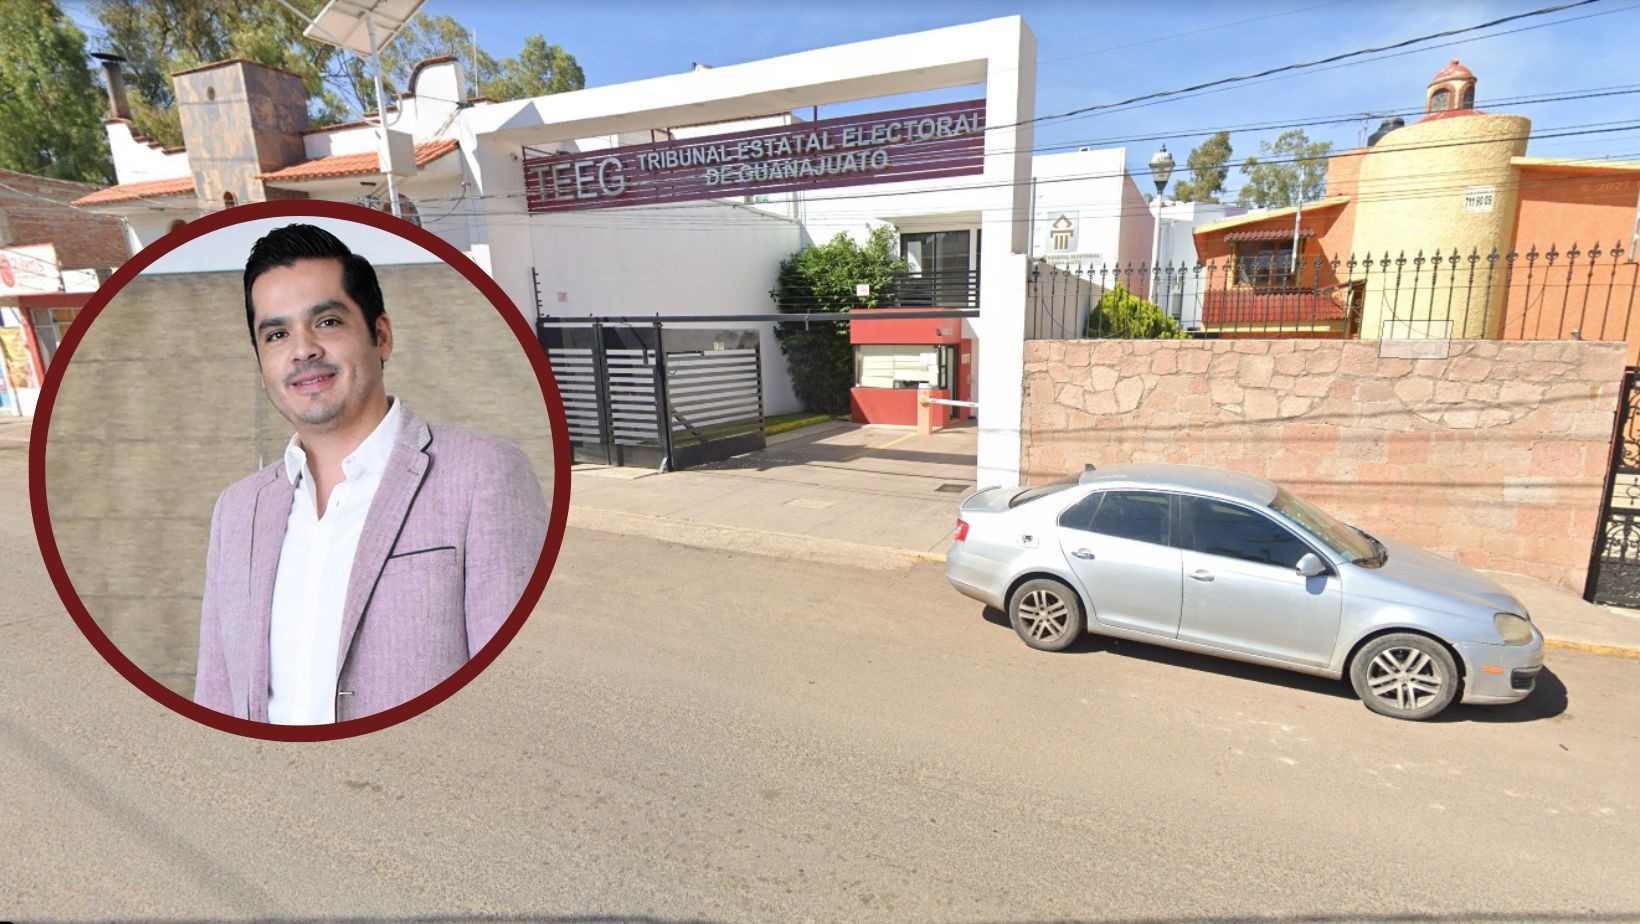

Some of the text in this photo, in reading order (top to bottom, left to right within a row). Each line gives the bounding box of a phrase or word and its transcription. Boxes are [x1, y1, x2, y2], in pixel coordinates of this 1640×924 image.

[636, 112, 985, 171] TRIBUNAL ESTATAL ELECTORAL
[529, 156, 626, 200] TEEG
[705, 150, 889, 186] DE GUANAJUATO
